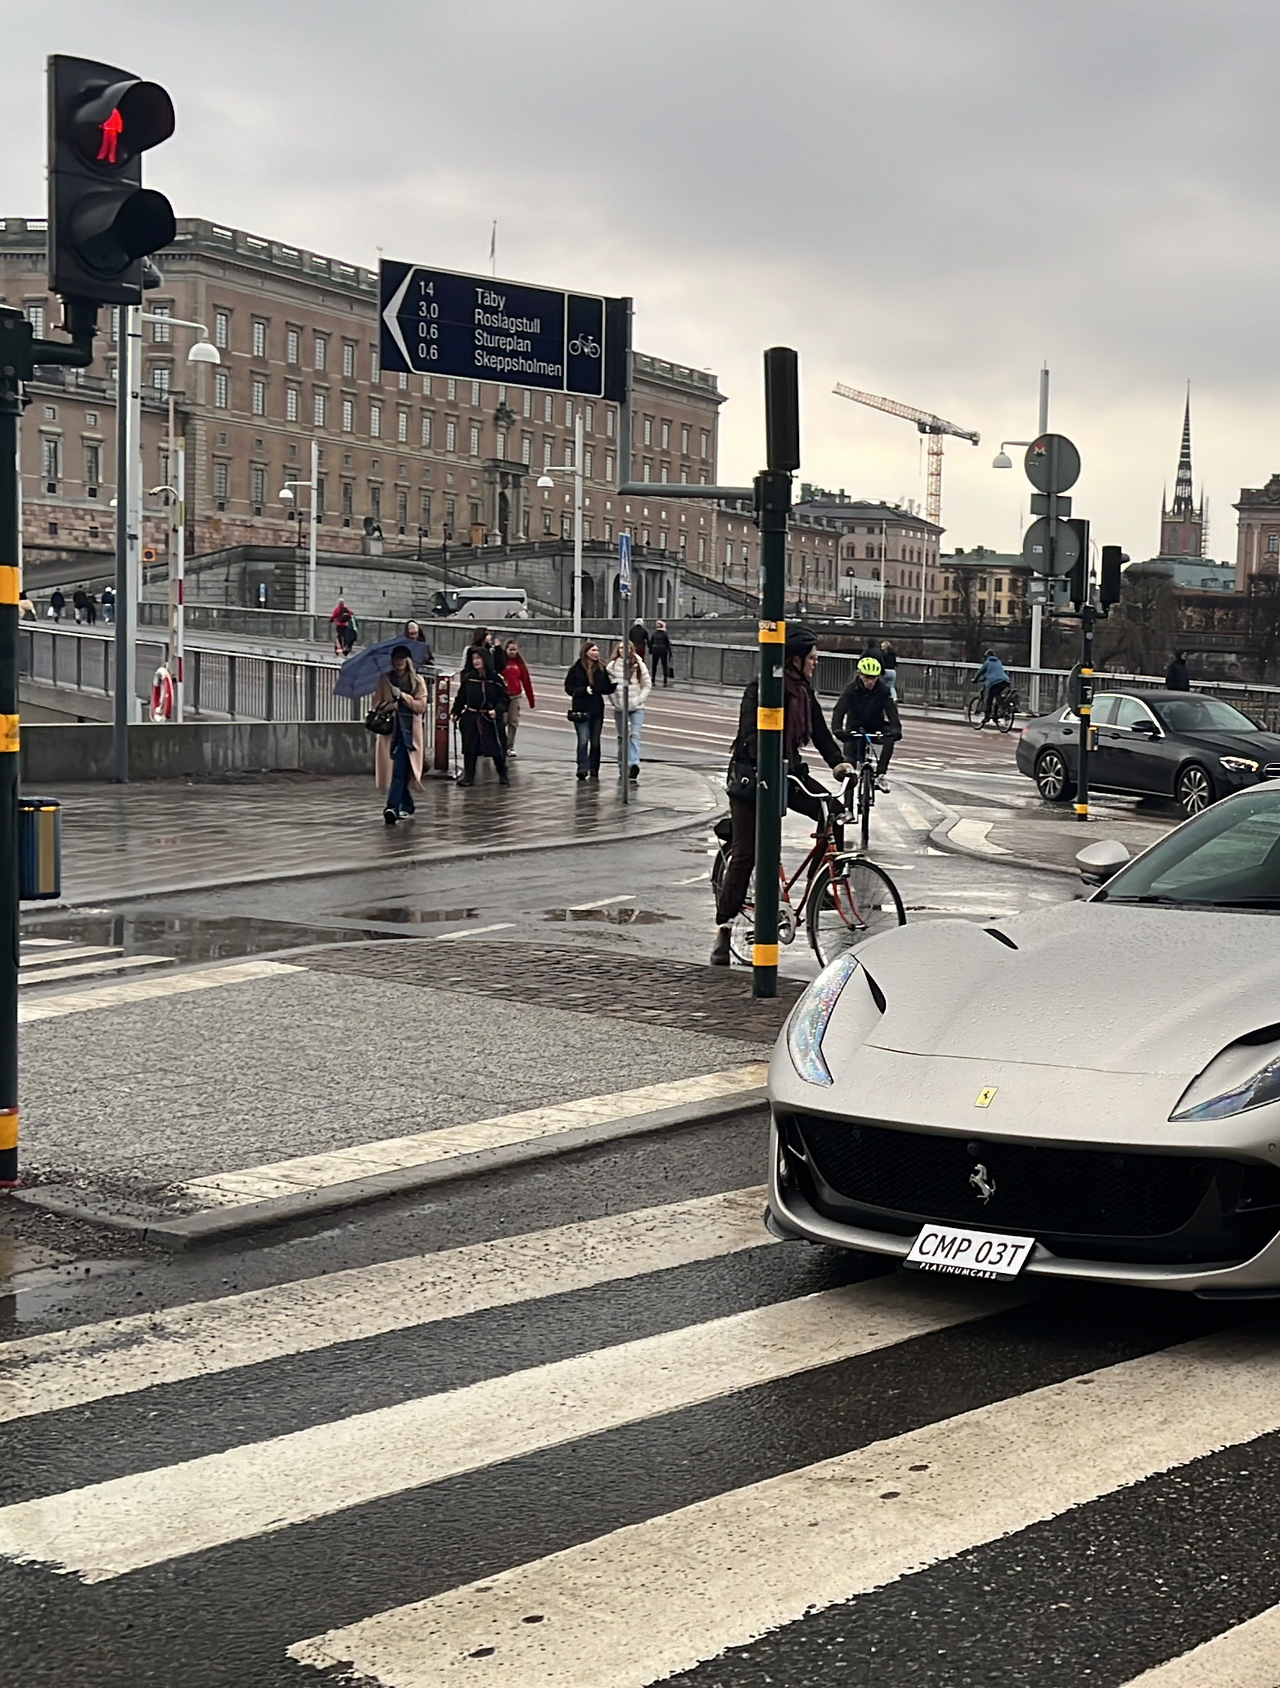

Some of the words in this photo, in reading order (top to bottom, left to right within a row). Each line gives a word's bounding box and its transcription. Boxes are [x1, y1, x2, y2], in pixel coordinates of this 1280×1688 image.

[418, 281, 434, 297] 14
[475, 287, 506, 311] Täby
[474, 310, 541, 334] Roslagstull
[474, 330, 532, 353] Stureplan
[474, 350, 562, 377] Skeppsholmen
[918, 1233, 973, 1260] CMP
[974, 1240, 1025, 1267] 03T
[919, 1262, 998, 1280] PLATINUMCARS
